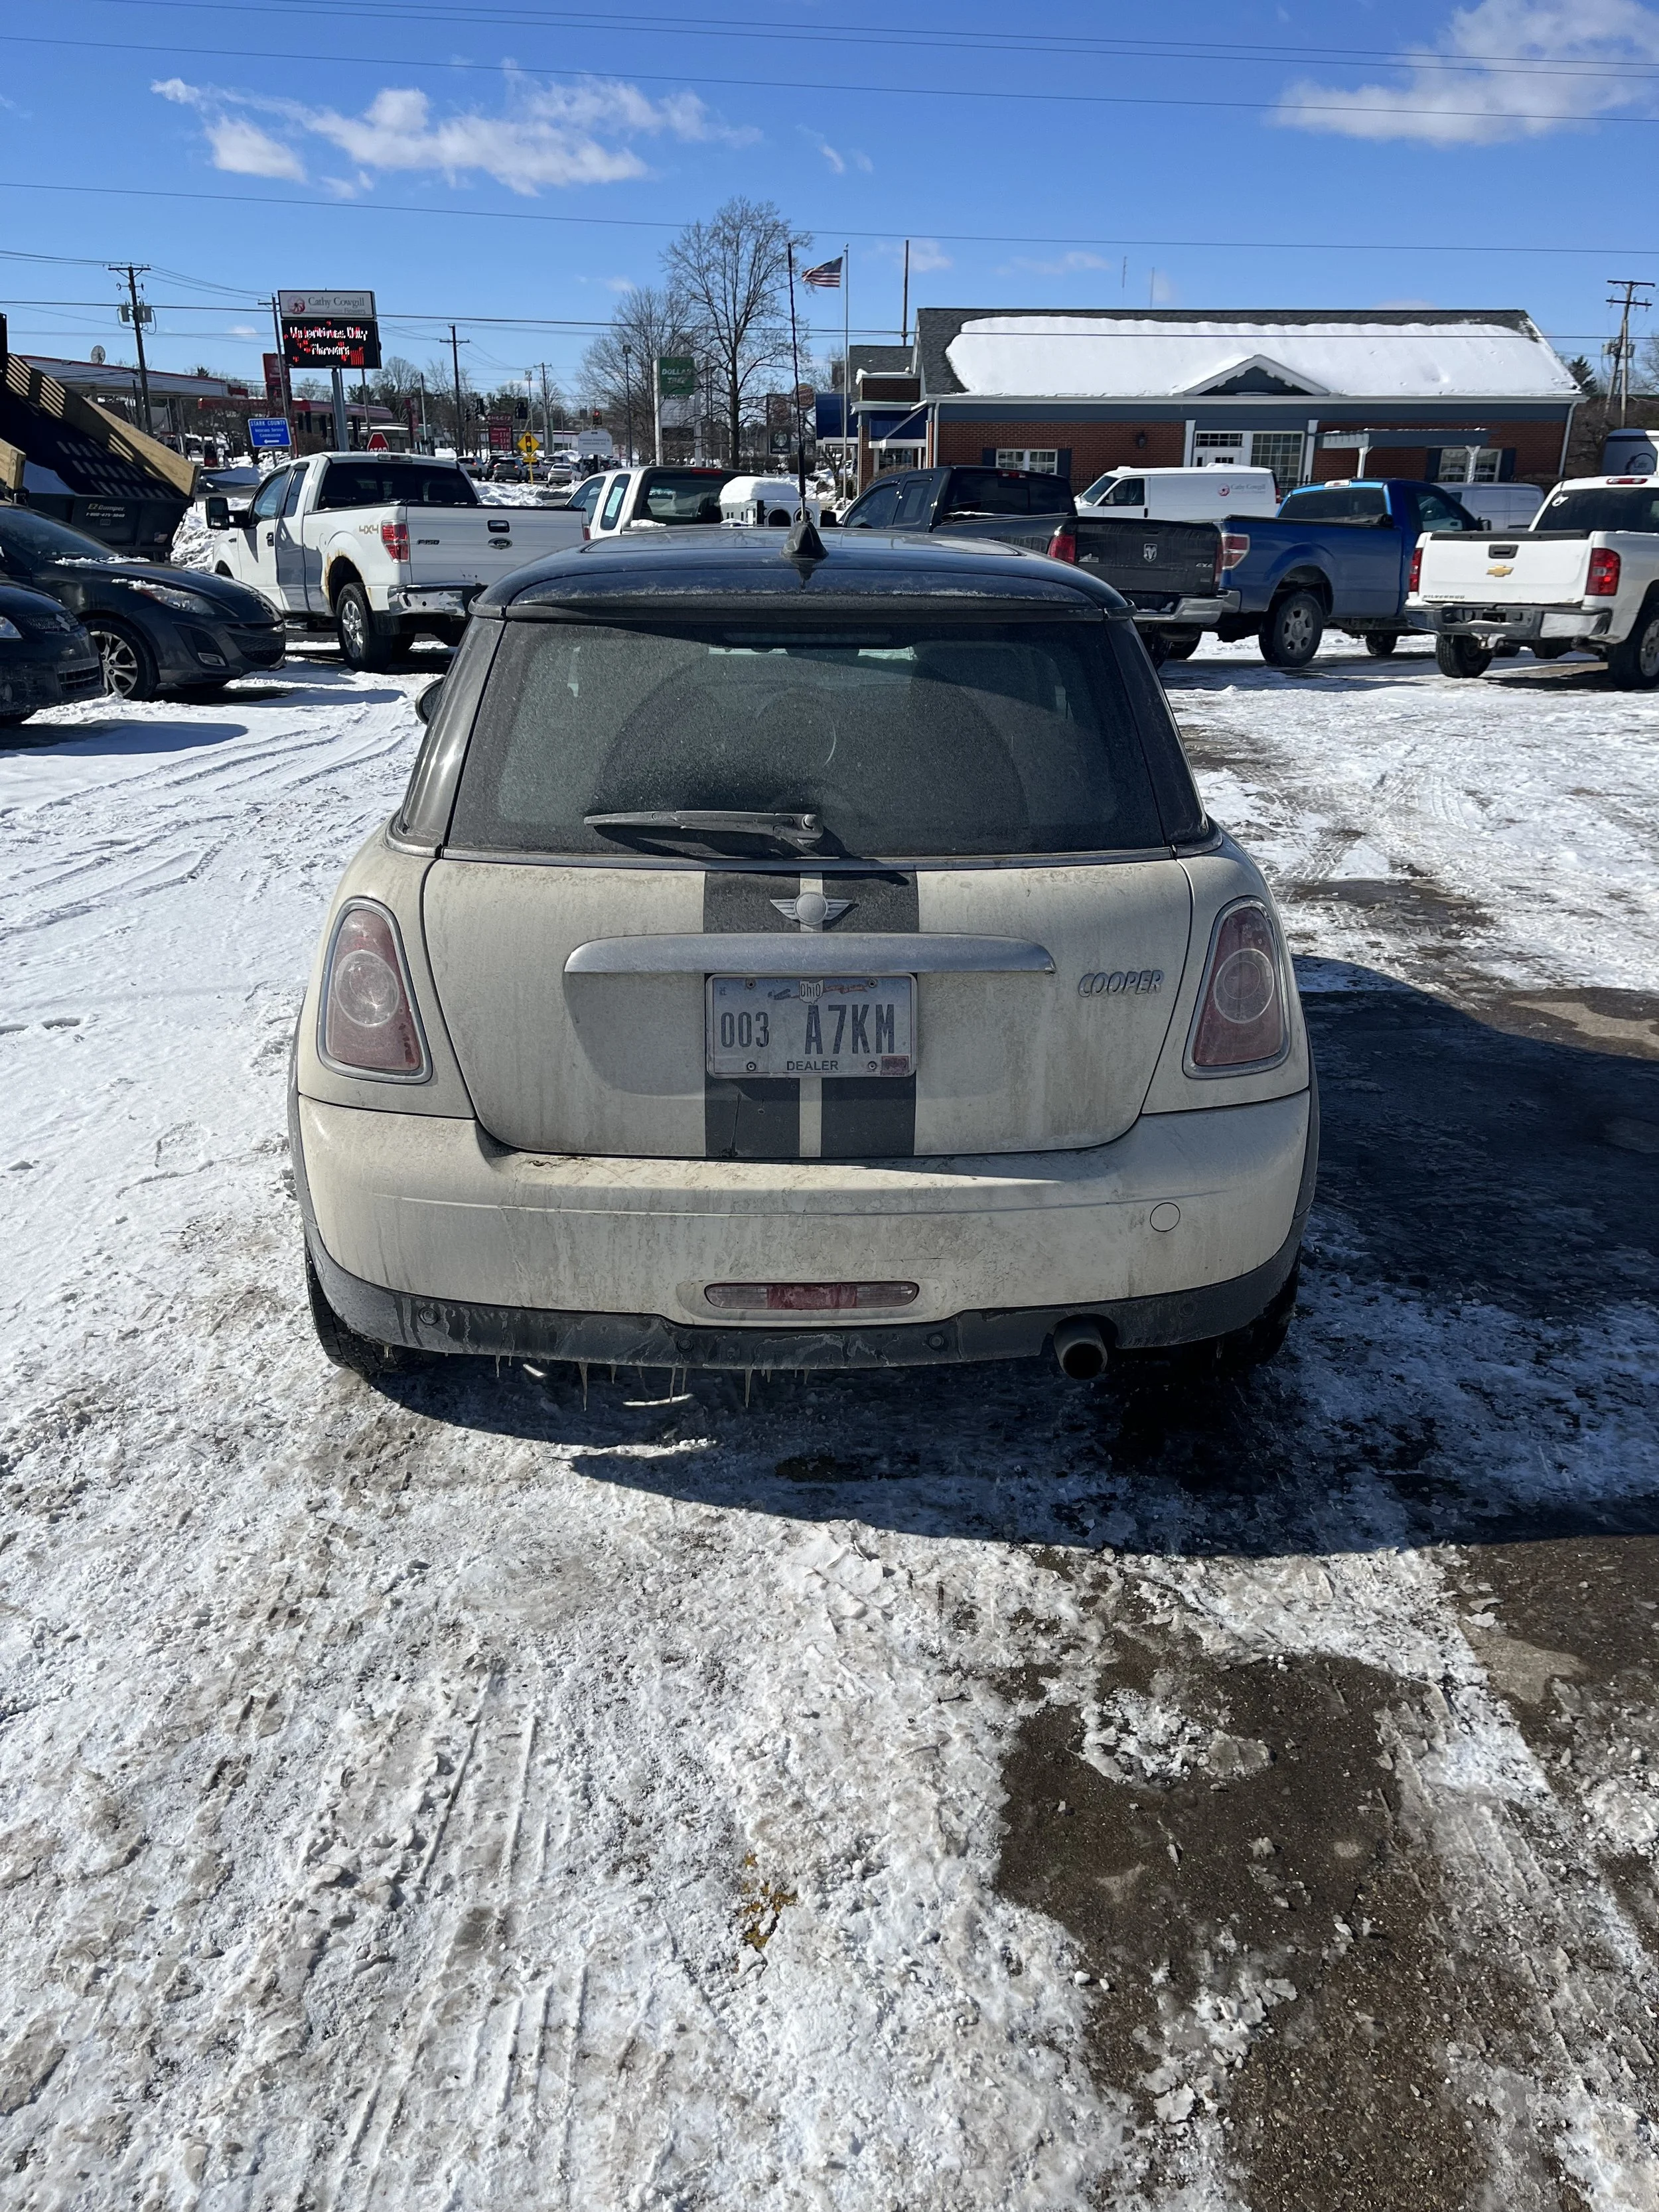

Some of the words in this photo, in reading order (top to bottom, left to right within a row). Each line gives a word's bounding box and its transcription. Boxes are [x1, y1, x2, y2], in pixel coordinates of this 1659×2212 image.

[308, 297, 330, 308] Cathy
[334, 297, 364, 308] Cowgill
[1078, 969, 1165, 998] COOPER
[720, 1011, 770, 1048] 003
[804, 1004, 895, 1055] A7KM
[786, 1061, 839, 1071] DEALER
